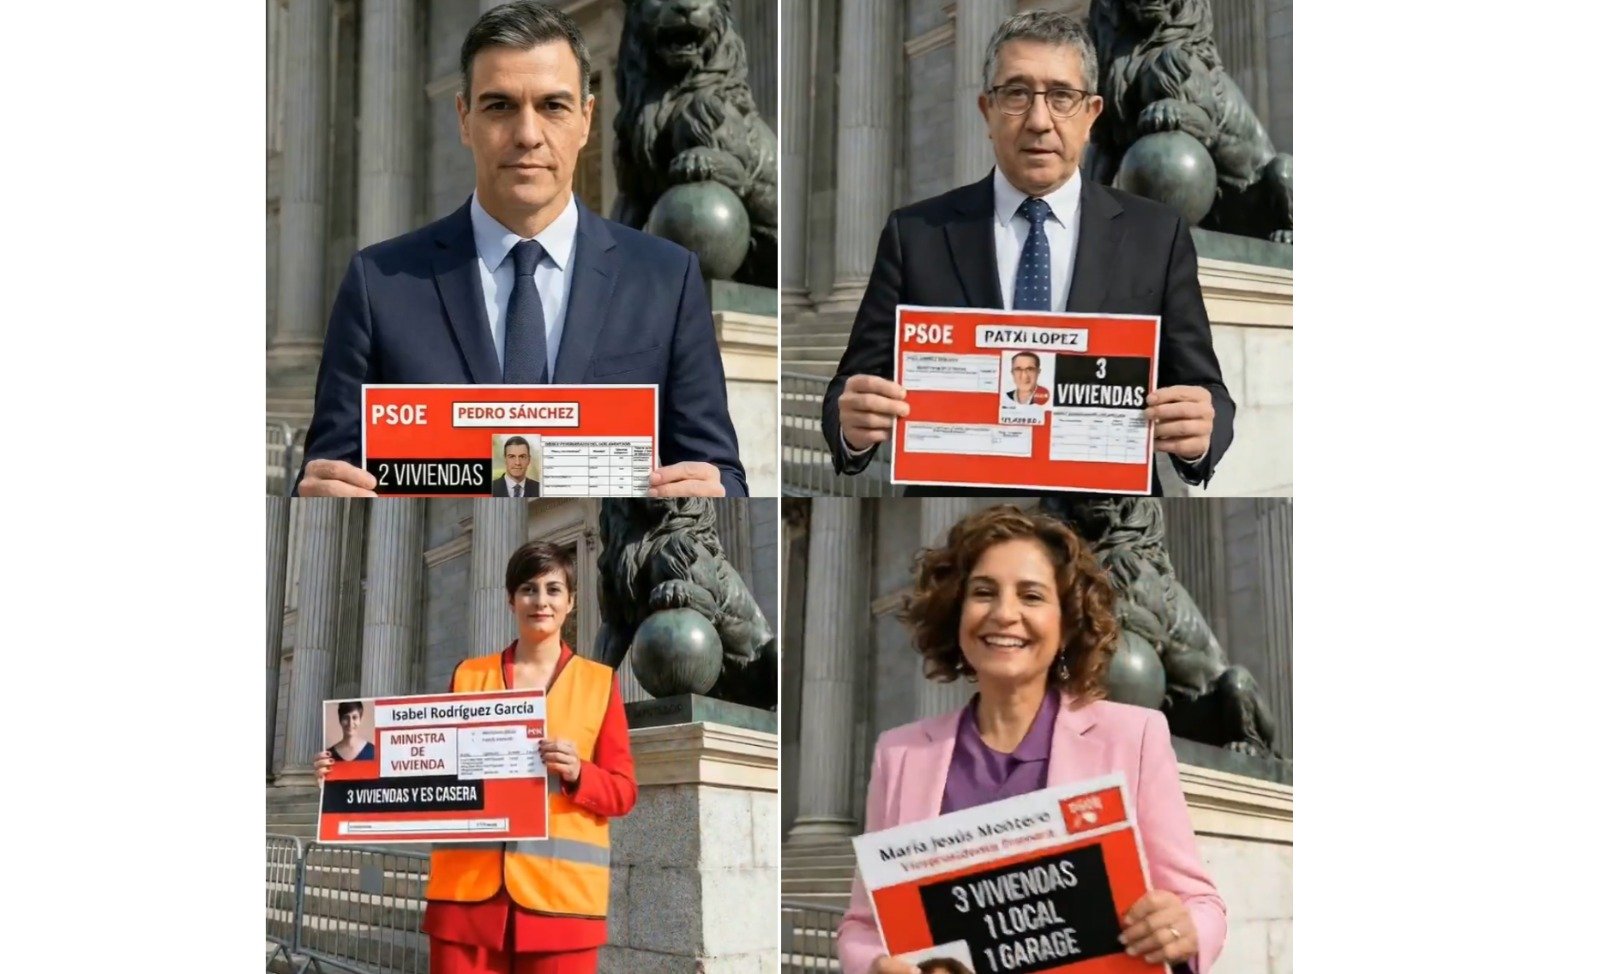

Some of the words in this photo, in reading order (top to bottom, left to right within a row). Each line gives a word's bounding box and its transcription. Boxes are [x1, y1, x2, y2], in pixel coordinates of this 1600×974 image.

[904, 323, 954, 344] PSOE
[1032, 332, 1079, 345] LOPEZ
[1096, 358, 1107, 379] 3
[1057, 384, 1144, 407] VIVIENDAS
[371, 404, 427, 425] PSOE
[458, 407, 505, 419] PEDRO
[509, 404, 574, 419] SÁNCHEZ
[379, 463, 389, 486] 2
[394, 463, 483, 486] VIVIENDAS
[392, 707, 427, 721] Isabel
[431, 703, 490, 720] Rodríguez
[494, 701, 534, 715] García
[390, 732, 446, 744] MINISTRA
[410, 747, 425, 757] DE
[391, 760, 445, 771] VIVIENDA
[347, 790, 354, 804] 3
[356, 788, 409, 803] VIVIENDAS
[412, 788, 420, 802] Y
[421, 787, 433, 802] ES
[436, 786, 477, 802] CASERA
[952, 886, 970, 913] 3
[972, 860, 1078, 909] VIVIENDAS
[984, 914, 997, 939] 1
[1000, 899, 1065, 937] LOCAL
[984, 948, 998, 972] 1
[999, 928, 1081, 969] GARAGE
